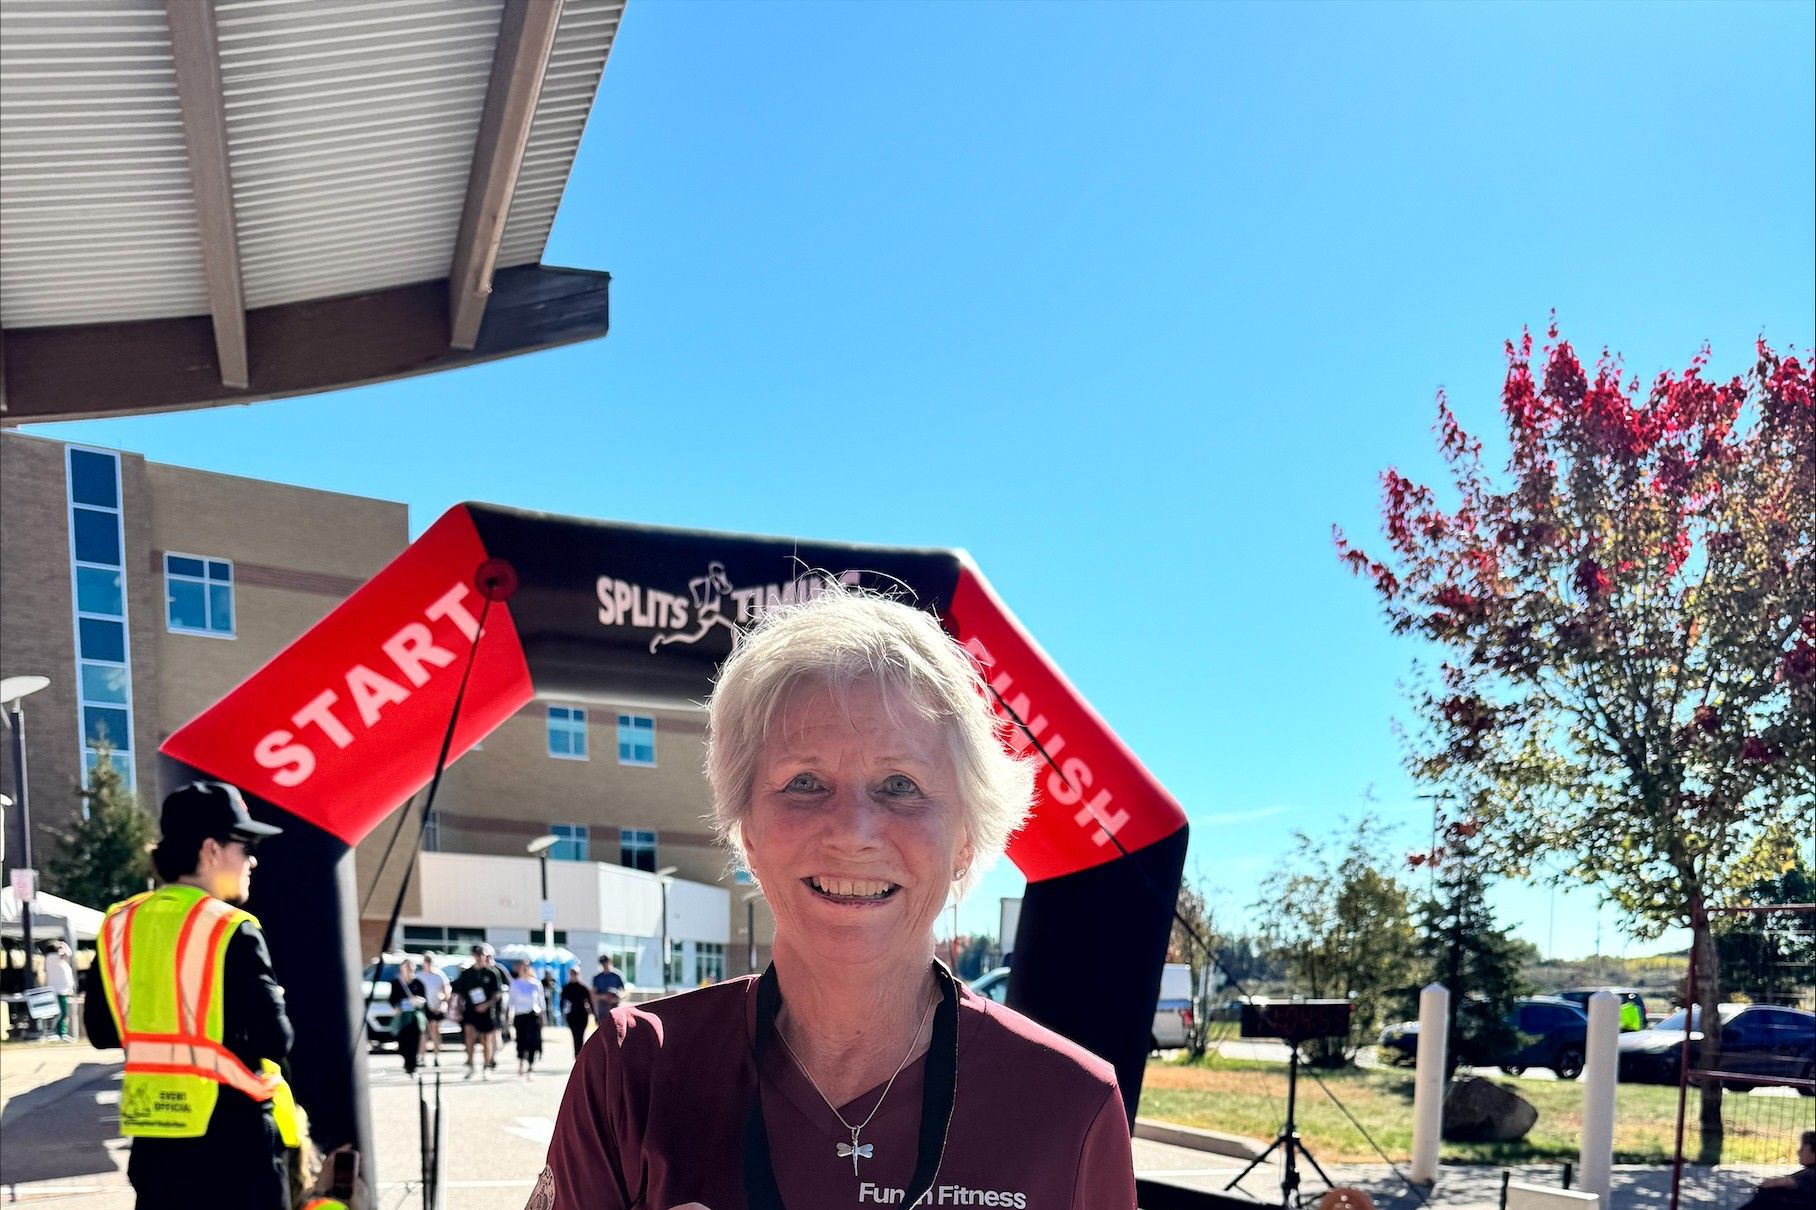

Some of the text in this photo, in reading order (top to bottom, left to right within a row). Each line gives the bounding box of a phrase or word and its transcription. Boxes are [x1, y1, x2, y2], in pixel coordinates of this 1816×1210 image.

[596, 575, 690, 629] SPLITS
[253, 581, 486, 788] START
[154, 1103, 191, 1113] OFFICIAL
[160, 1091, 187, 1101] EVENT
[859, 1182, 906, 1204] Fun
[938, 1184, 1027, 1210] Fitness
